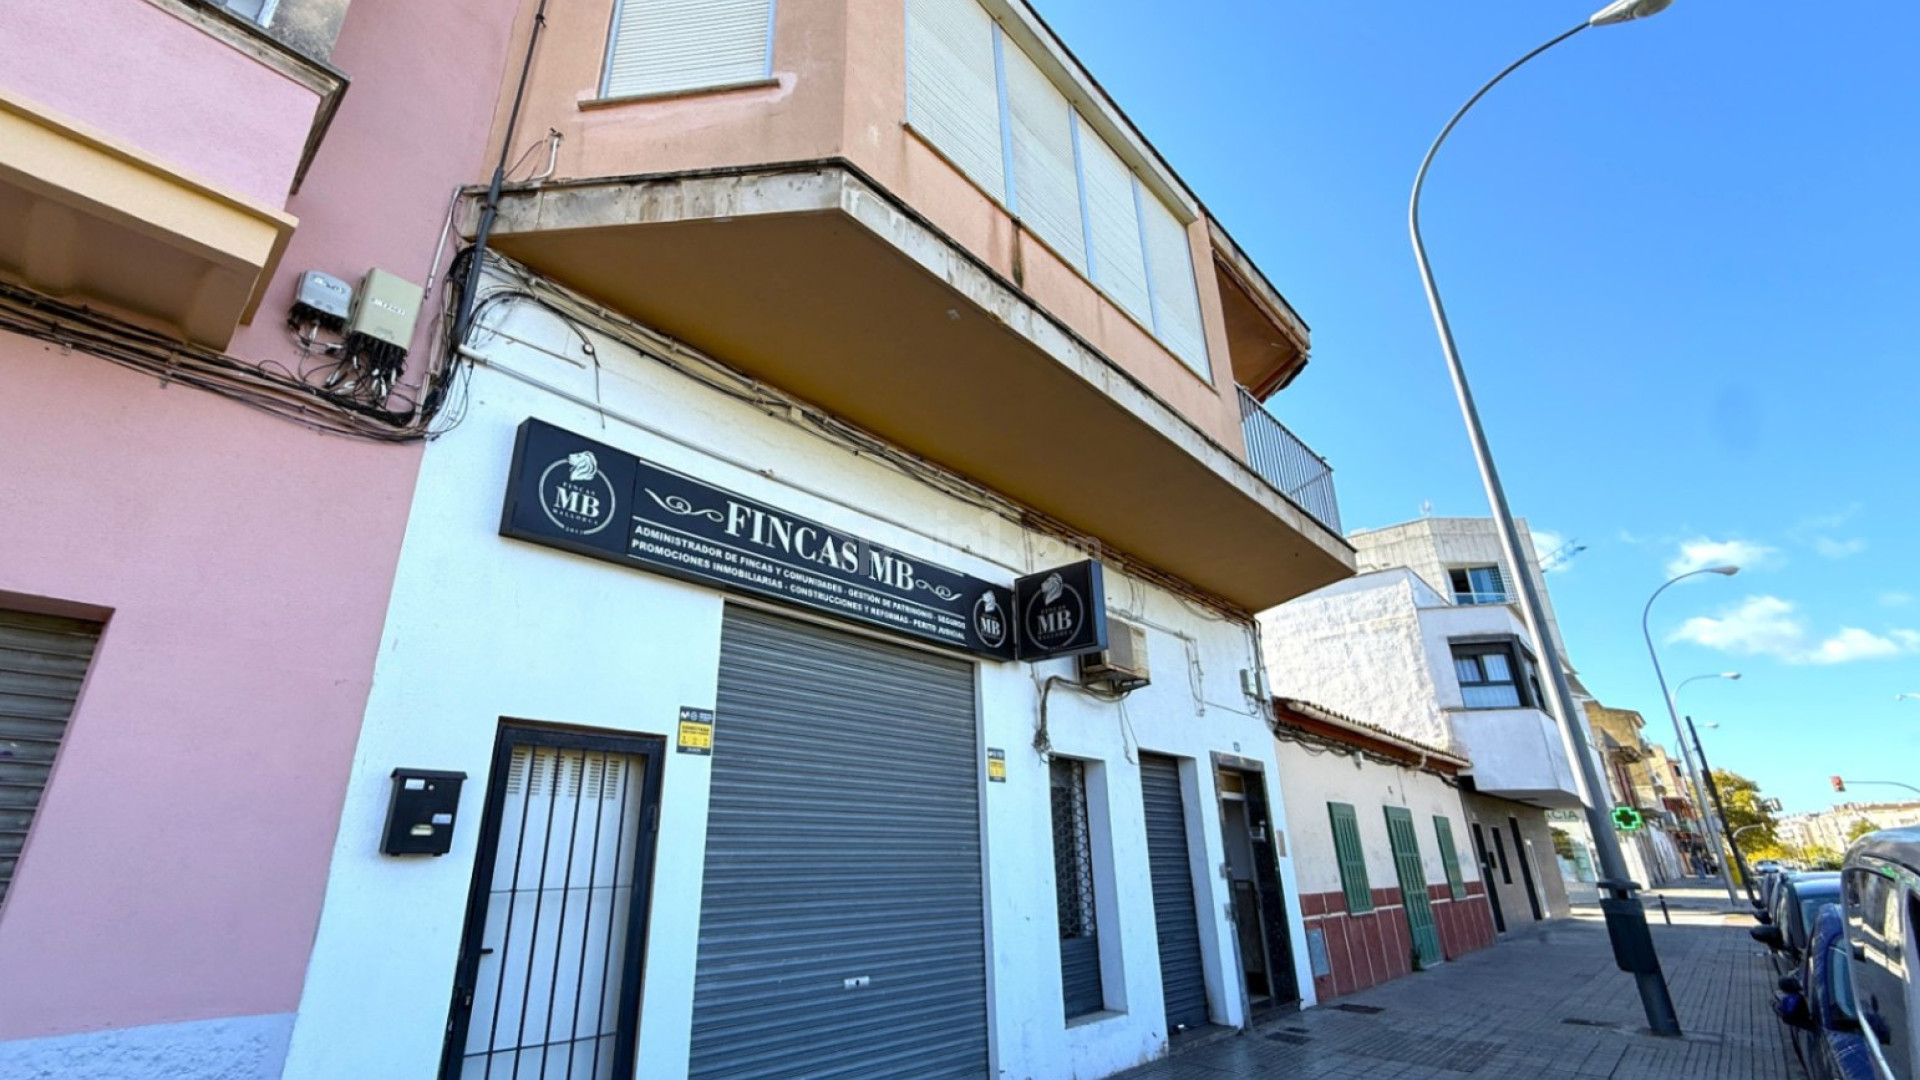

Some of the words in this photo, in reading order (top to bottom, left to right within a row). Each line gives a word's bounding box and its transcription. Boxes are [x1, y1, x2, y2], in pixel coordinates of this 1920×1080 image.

[553, 486, 600, 518] MB
[634, 525, 723, 559] ADMINISTRADOR
[724, 552, 738, 564] DE
[739, 556, 773, 574] FINCAS
[776, 566, 783, 576] Y
[782, 570, 843, 594] COMUNIDADES
[724, 500, 859, 574] FINCAS
[868, 549, 915, 592] MB
[631, 538, 711, 569] PROMOCIONES
[712, 561, 783, 590] INMOBILIARIAS
[789, 584, 863, 612] CONSTRUCCIONES
[980, 616, 1001, 636] MB
[1037, 609, 1072, 635] MB
